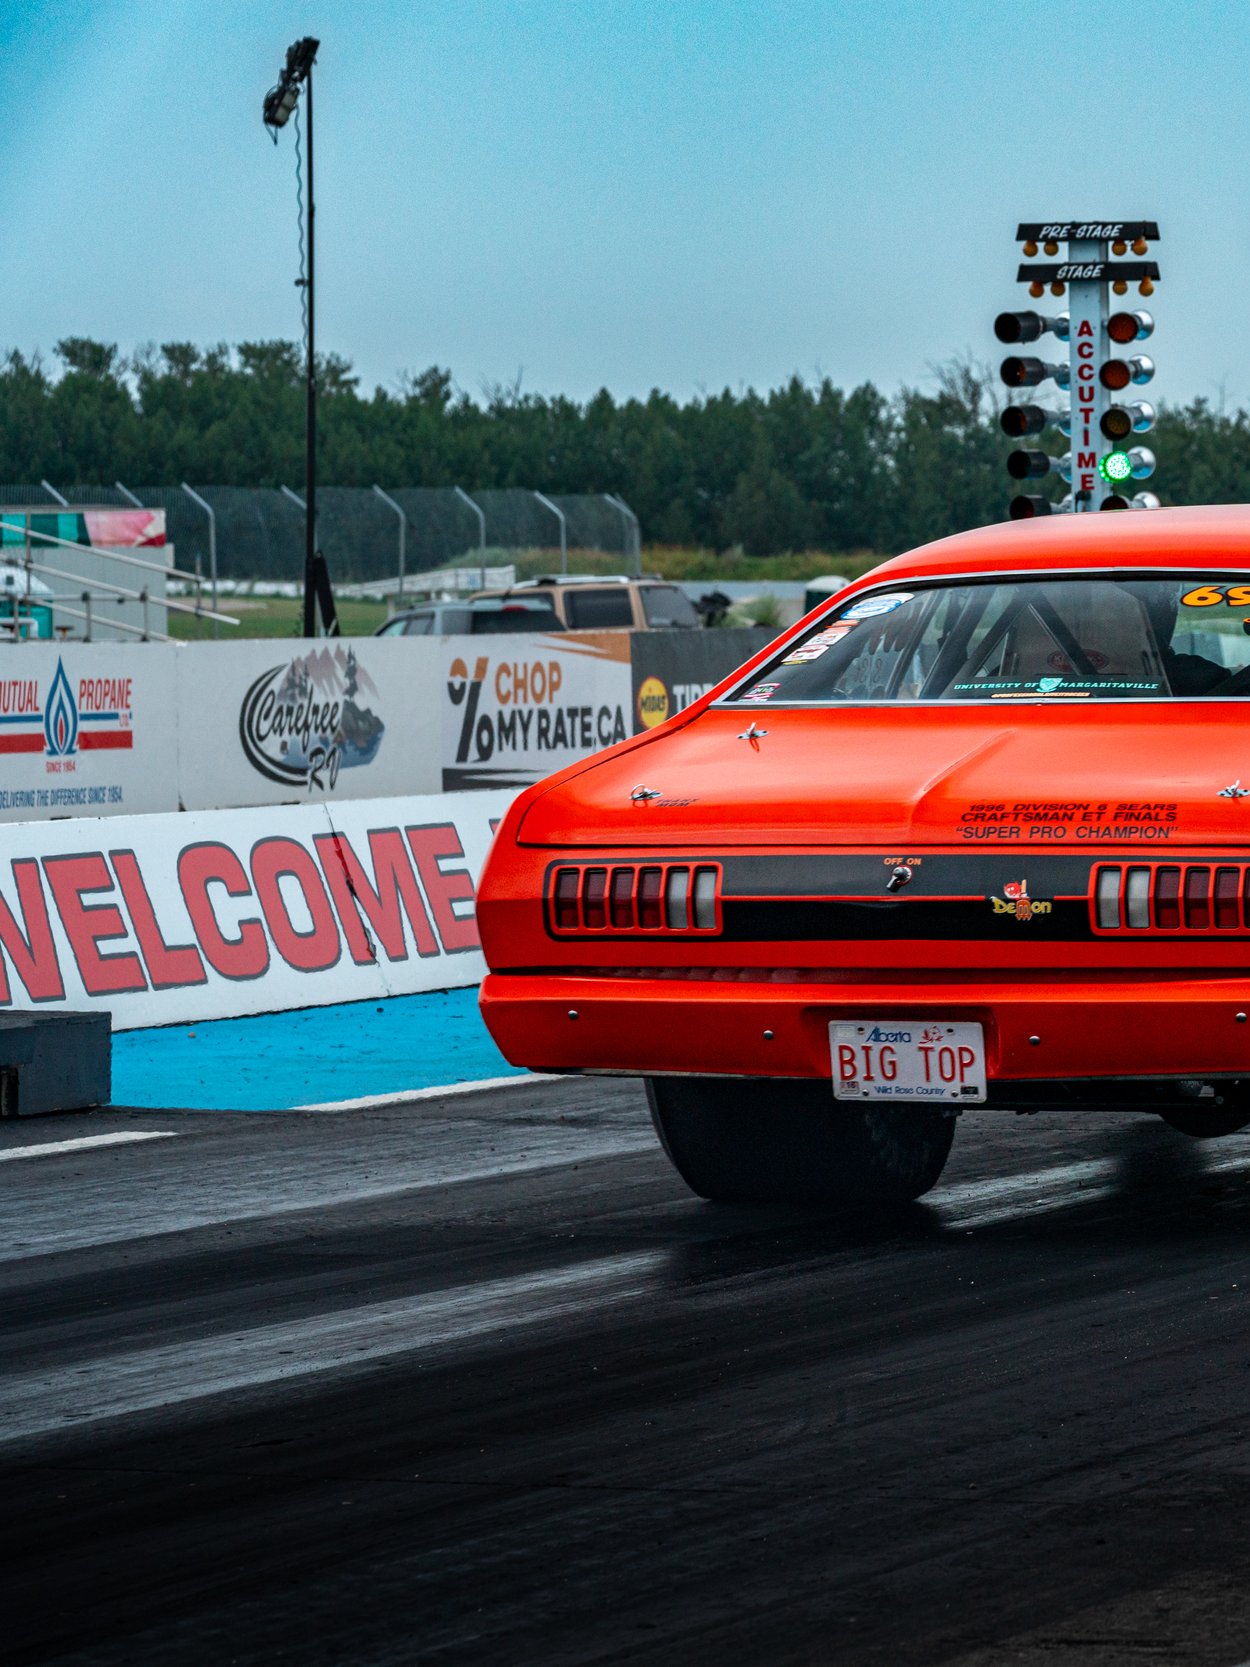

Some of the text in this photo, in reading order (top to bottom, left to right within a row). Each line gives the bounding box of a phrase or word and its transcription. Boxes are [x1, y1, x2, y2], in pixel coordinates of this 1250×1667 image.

[1039, 224, 1123, 239] PRE-STAGE
[1056, 264, 1104, 279] STAGE
[1077, 320, 1096, 490] ACCUTIME
[495, 661, 562, 705] CHOP
[1059, 682, 1159, 690] MARGARITAVILLE
[0, 678, 133, 713] UTUAL PROPANE
[256, 684, 339, 752] Carefree
[46, 761, 62, 773] SINCE
[308, 744, 342, 792] RV
[37, 789, 49, 807] THE
[51, 787, 87, 806] DIFFERENCE
[88, 786, 107, 804] SINCE
[969, 803, 1178, 812] 1996 DIVISION 6 SEARS
[961, 812, 1177, 822] CRAFTSMAN ET FINALS
[1029, 826, 1067, 839] PRO
[883, 857, 921, 865] OFF ON
[0, 822, 477, 1006] WELCOME
[866, 1026, 912, 1043] Alberta
[838, 1044, 976, 1082] BIG TOP
[874, 1086, 946, 1096] Wild Rose Country
